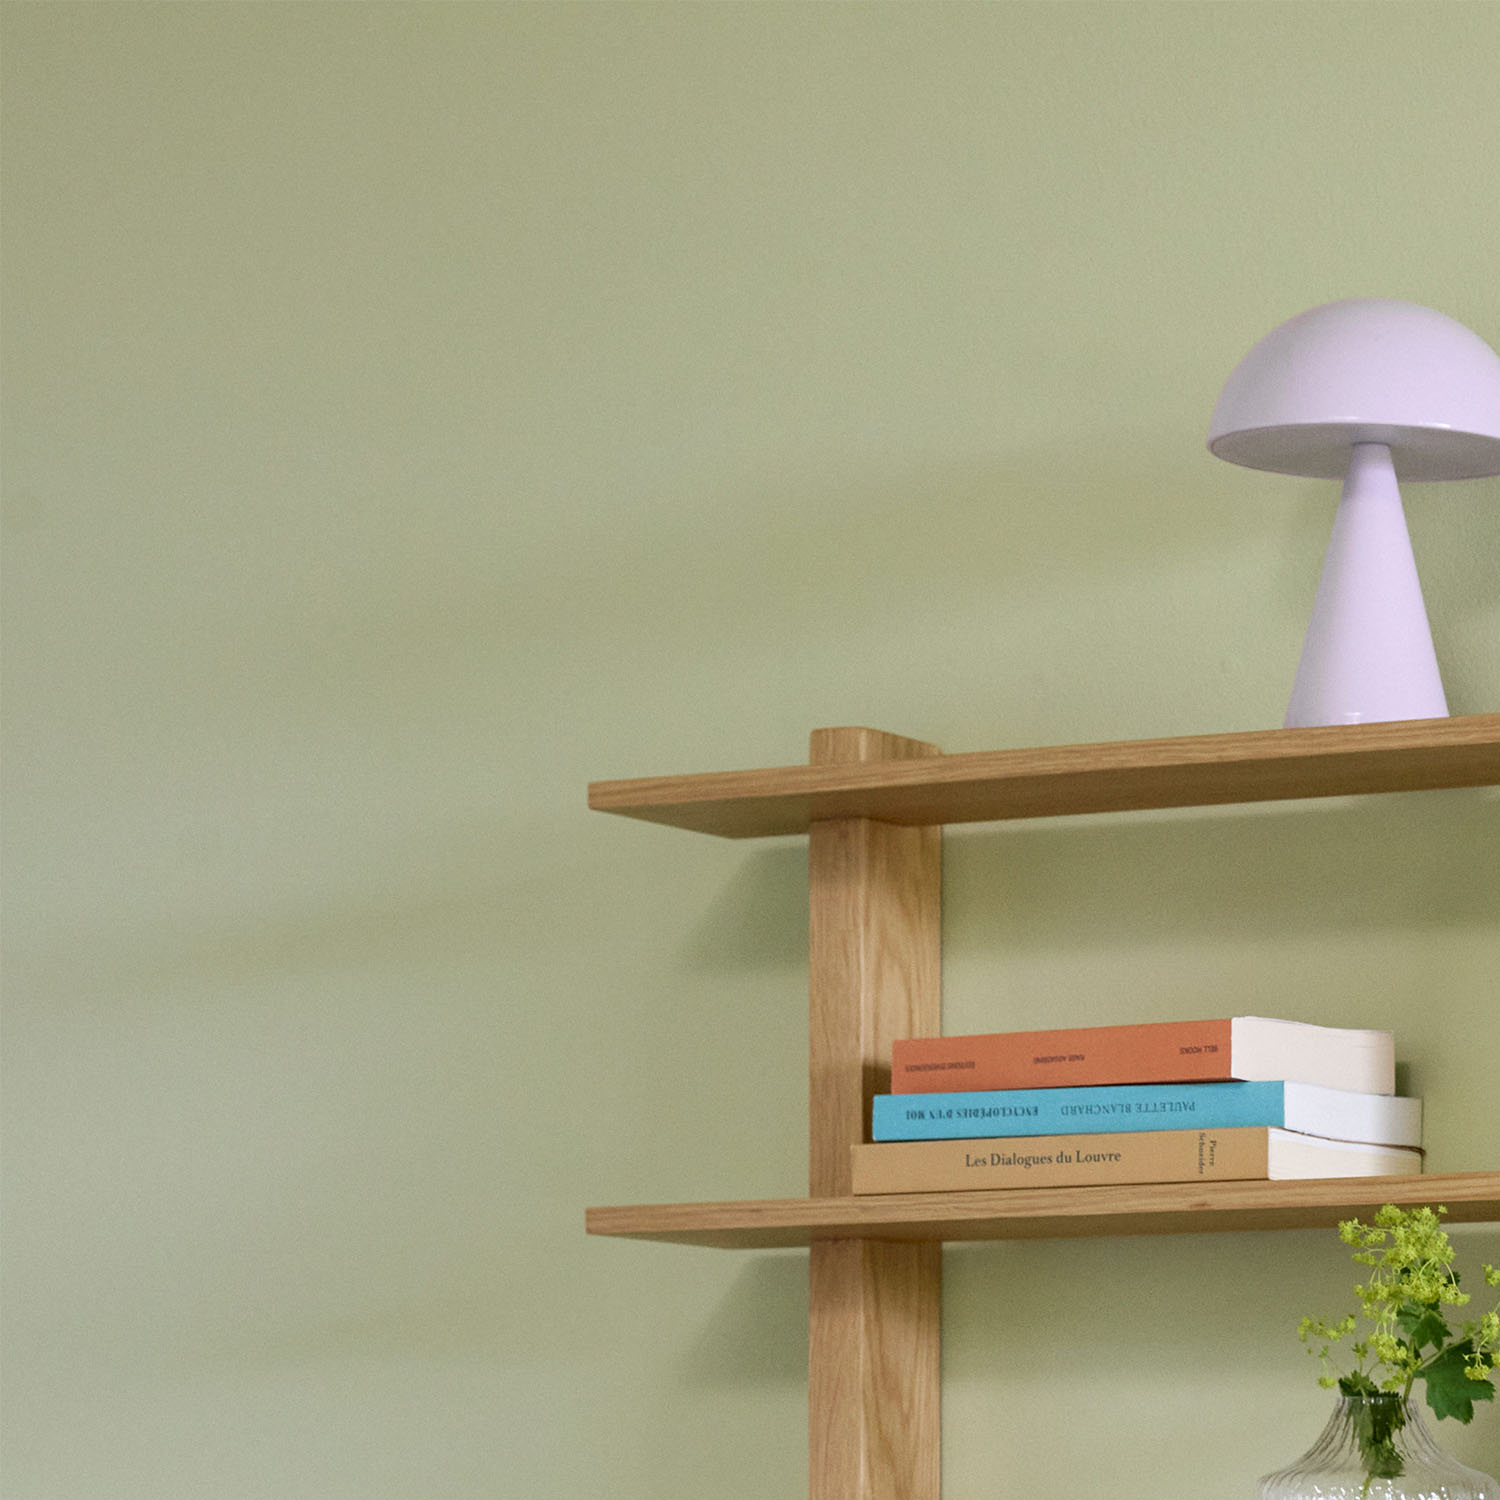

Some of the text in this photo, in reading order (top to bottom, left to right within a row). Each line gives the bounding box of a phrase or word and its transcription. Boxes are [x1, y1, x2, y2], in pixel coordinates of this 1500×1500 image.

[906, 1110, 926, 1121] MOI
[956, 1106, 1039, 1120] ENCYCLOPÉDIES
[1060, 1101, 1196, 1117] PAULETTE BLANCHARD
[965, 1150, 1122, 1169] Les Dialogues du Louvre
[1198, 1132, 1206, 1175] Schneider
